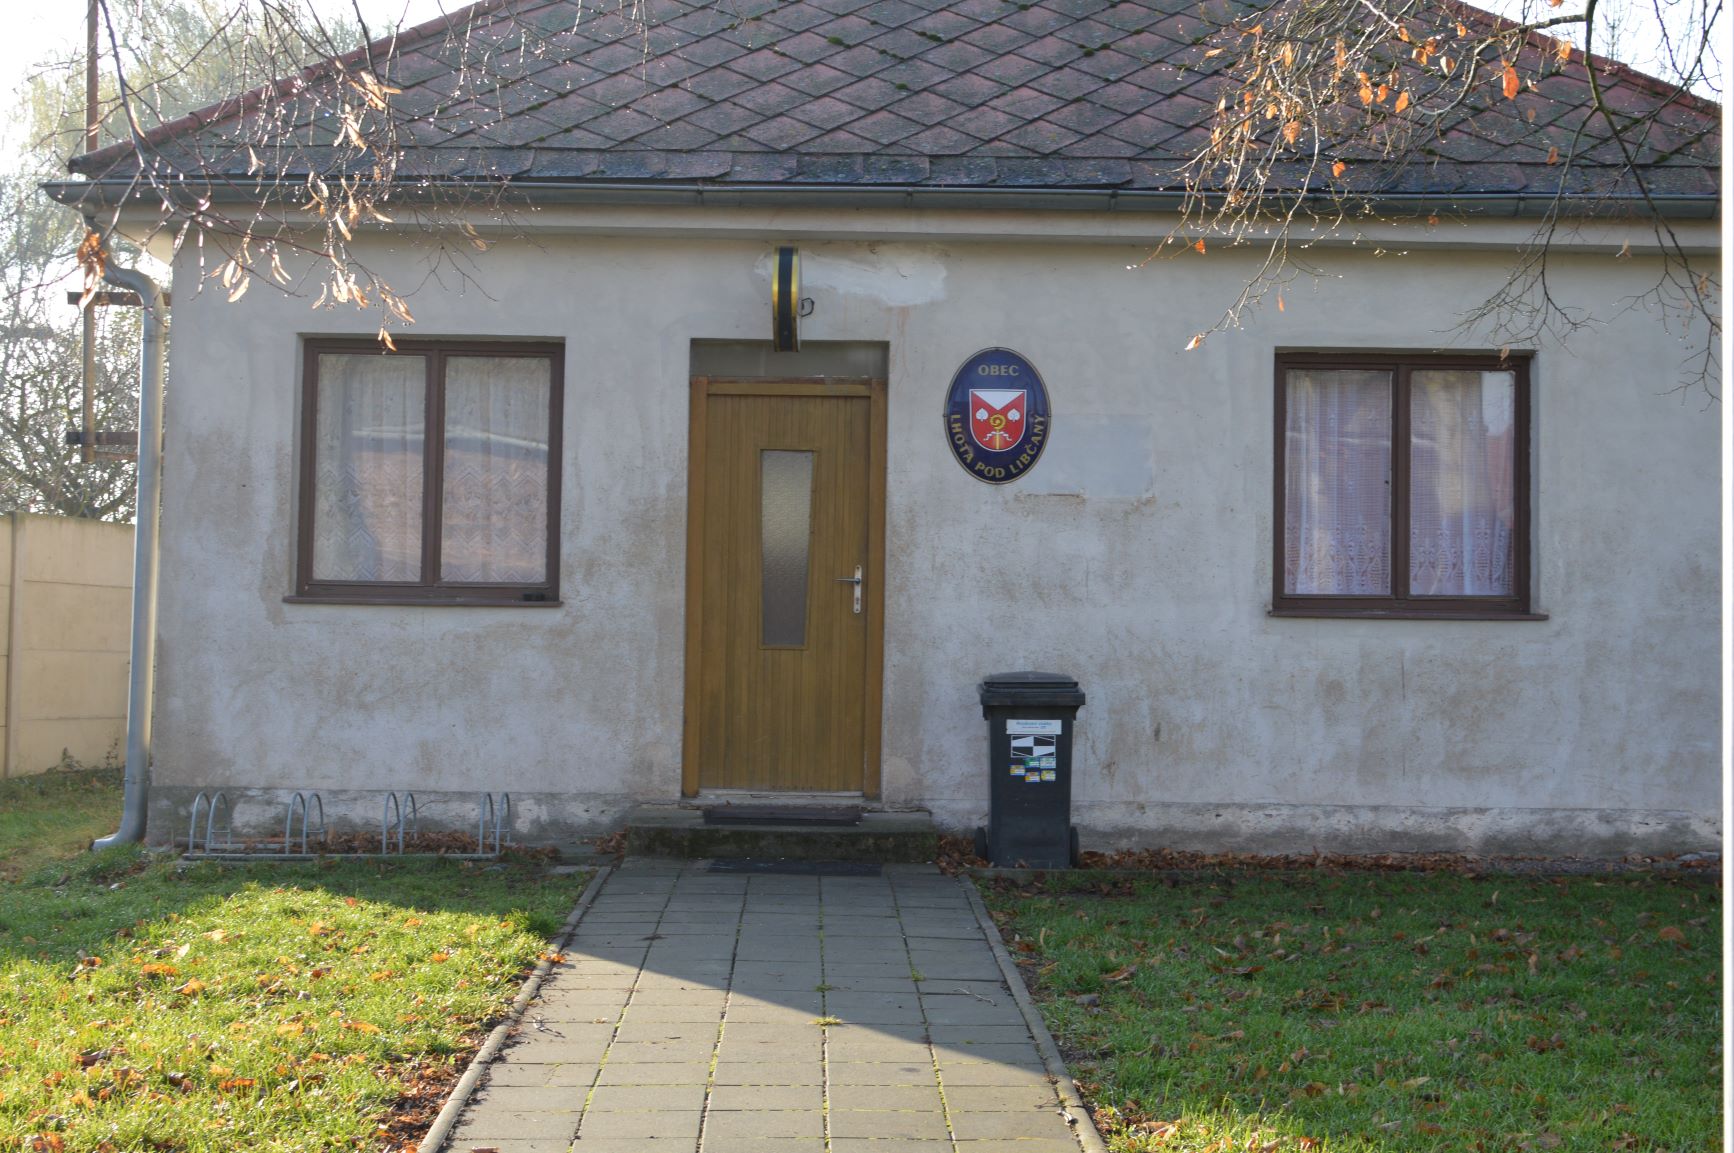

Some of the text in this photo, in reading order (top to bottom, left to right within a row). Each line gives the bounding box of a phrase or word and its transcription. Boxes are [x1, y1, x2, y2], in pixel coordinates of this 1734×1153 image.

[978, 365, 1019, 376] OBEC
[951, 414, 1045, 478] LHOTA POD LIBČANY
